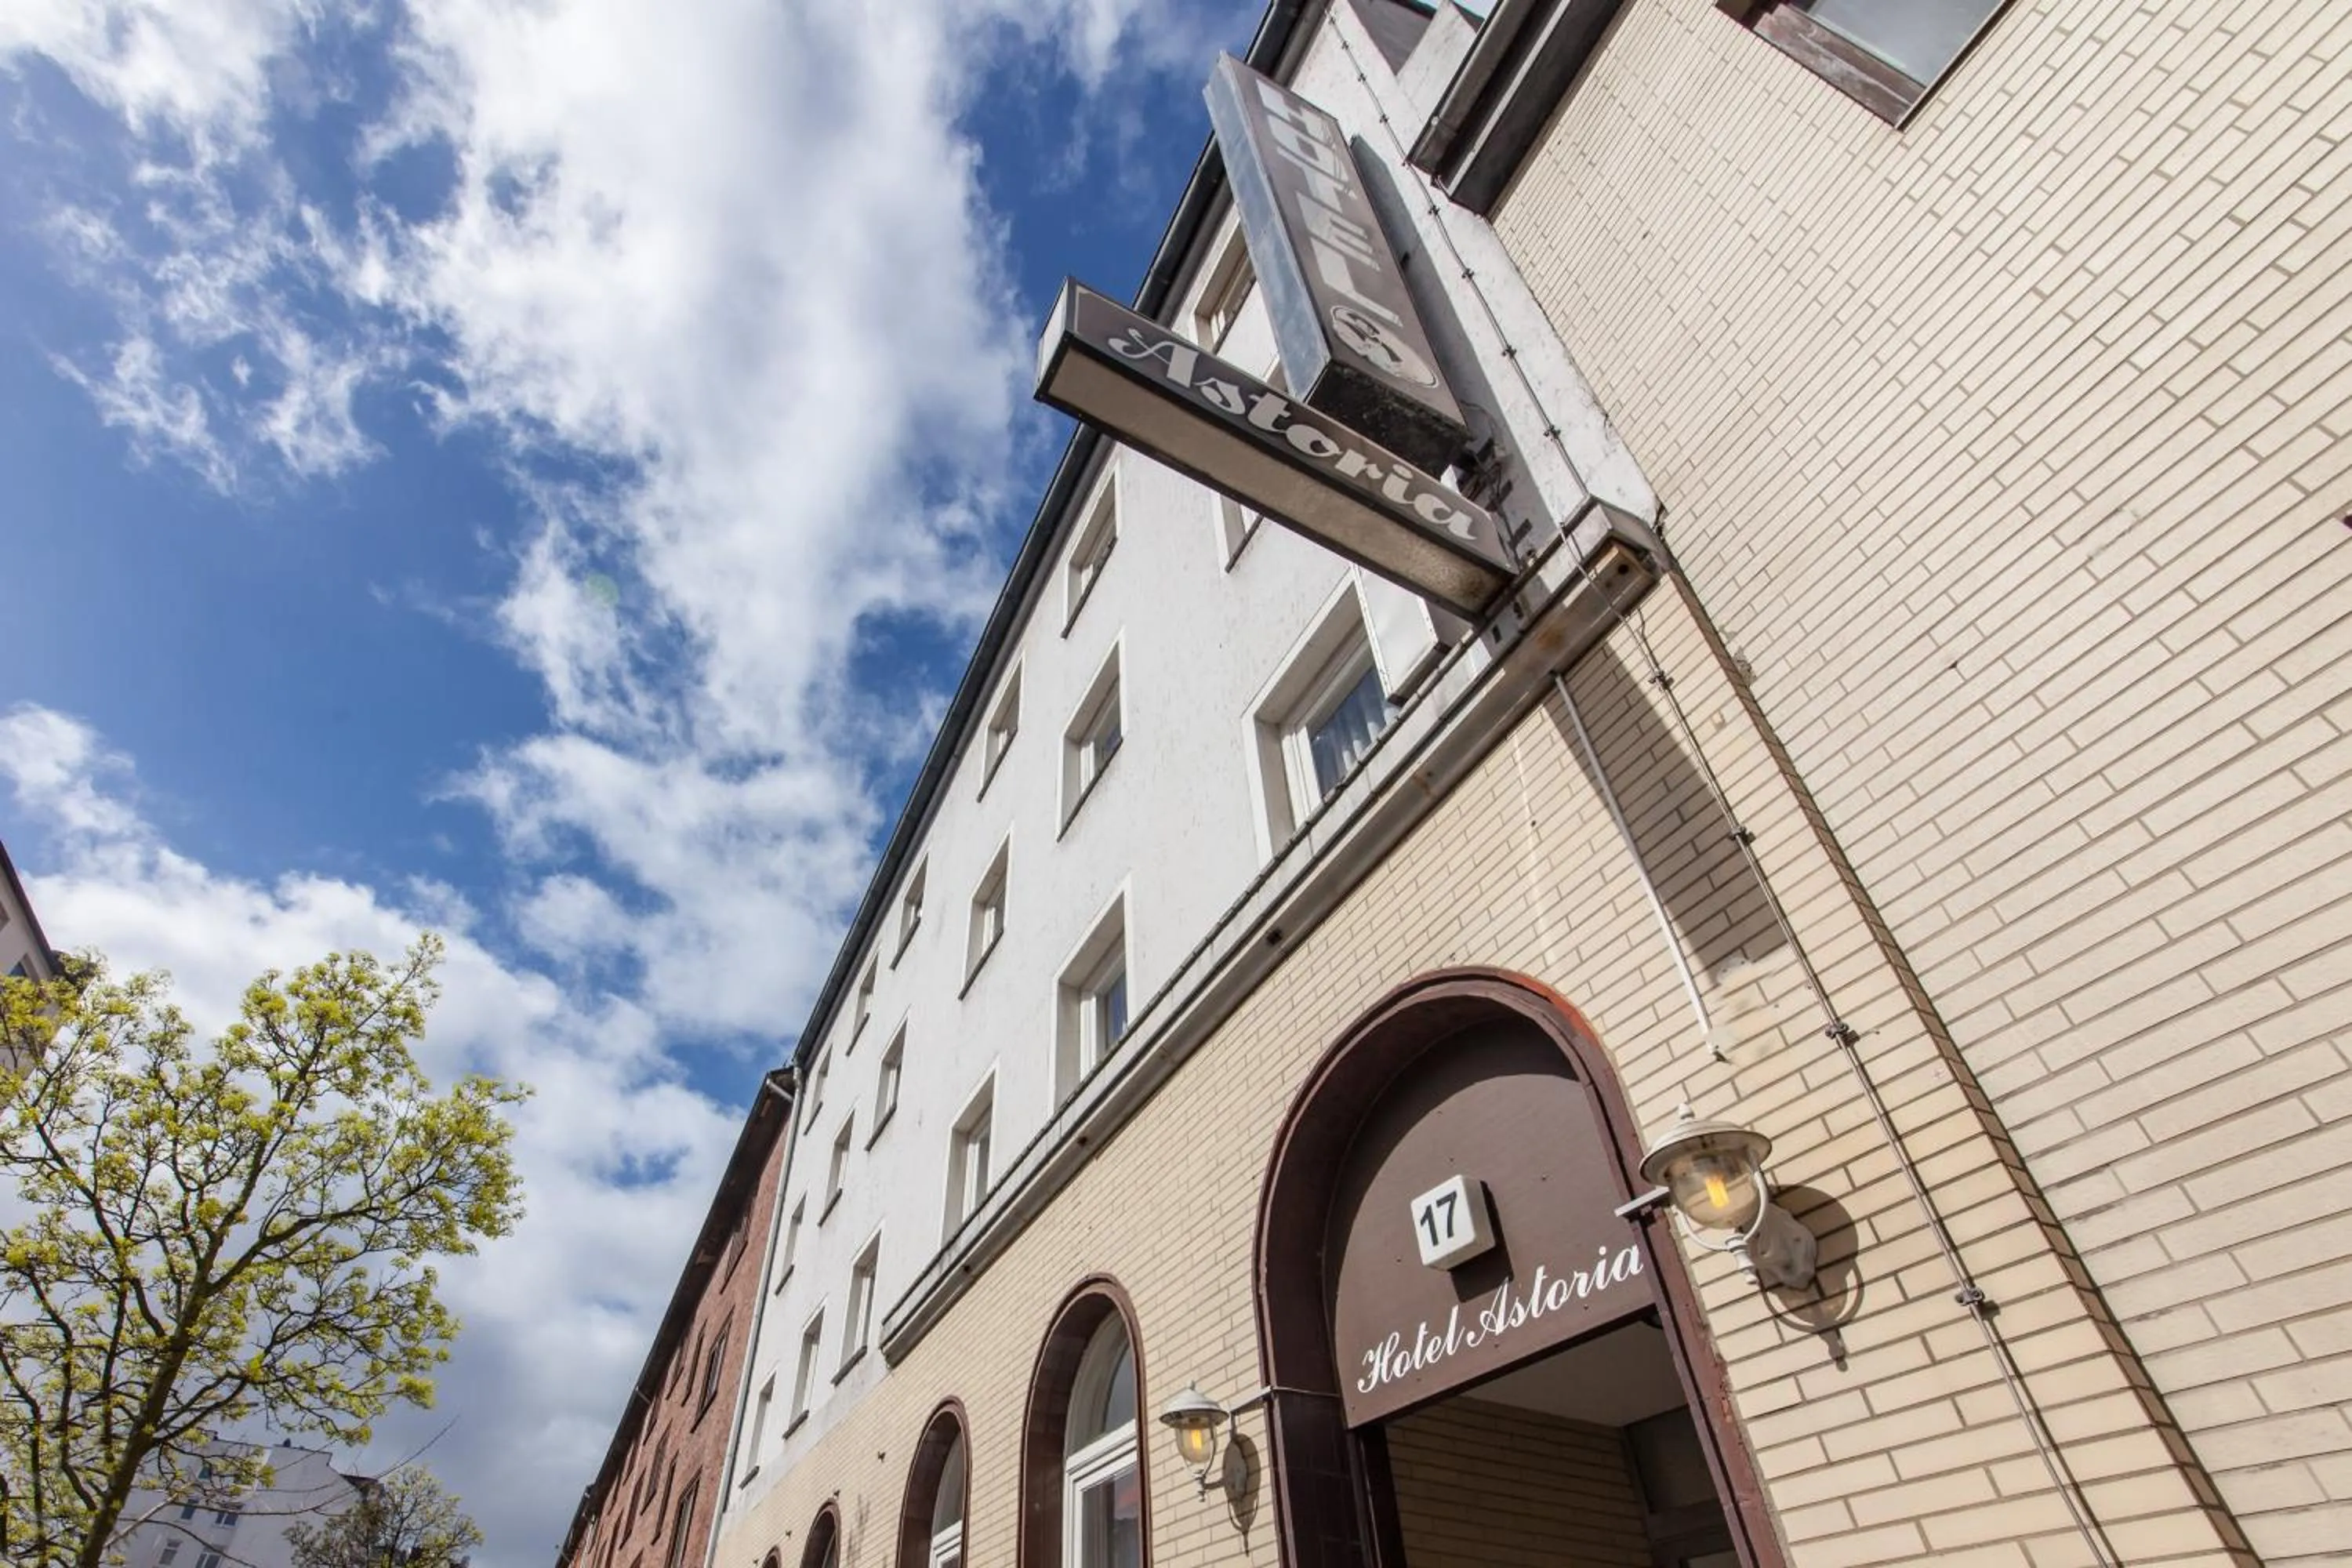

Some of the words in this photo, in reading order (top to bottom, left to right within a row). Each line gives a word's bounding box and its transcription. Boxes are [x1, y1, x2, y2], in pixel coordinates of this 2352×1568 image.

[1255, 79, 1403, 327] HOTEL
[1108, 327, 1477, 540] Astoria
[1420, 1191, 1457, 1247] 17
[1357, 1305, 1465, 1393] Hotel
[1466, 1244, 1644, 1348] Astoria
